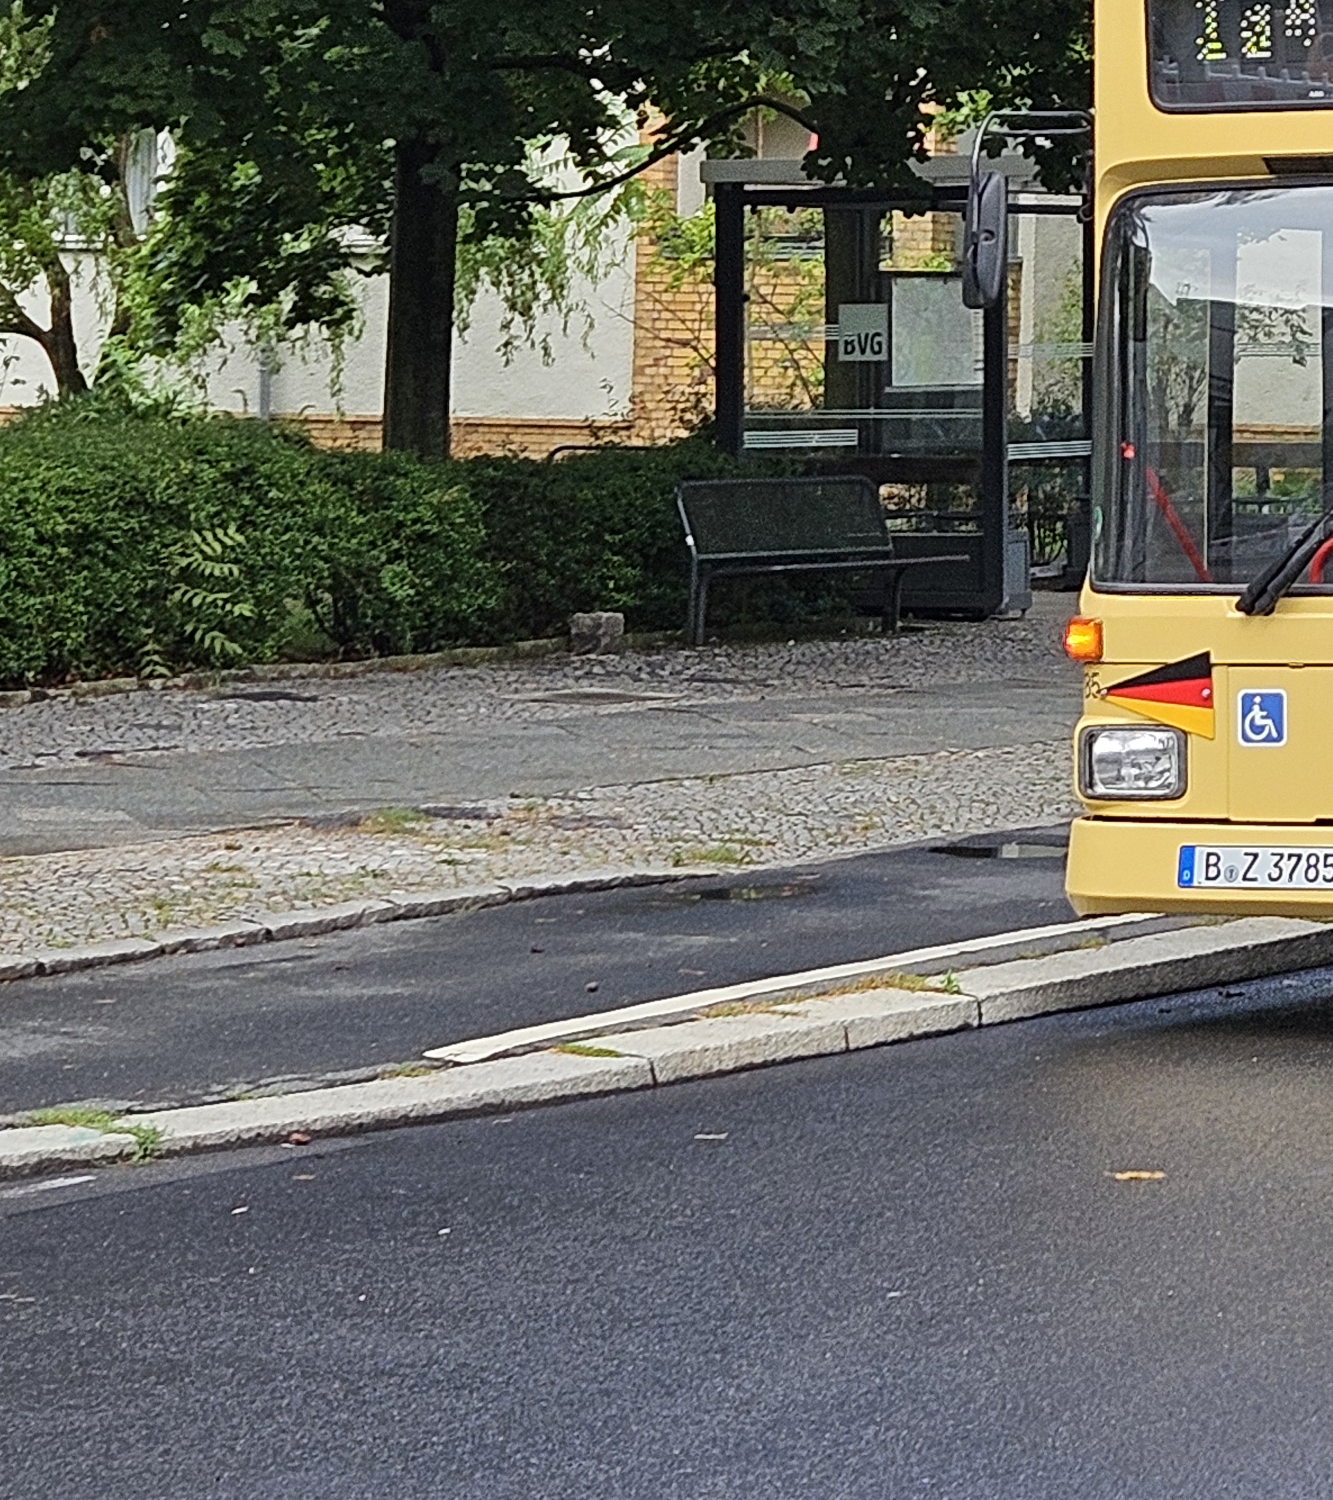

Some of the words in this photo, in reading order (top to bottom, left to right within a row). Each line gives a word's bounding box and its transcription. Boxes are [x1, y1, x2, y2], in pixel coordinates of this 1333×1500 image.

[843, 331, 883, 356] BVG
[1204, 851, 1222, 882] B
[1241, 851, 1260, 883] Z
